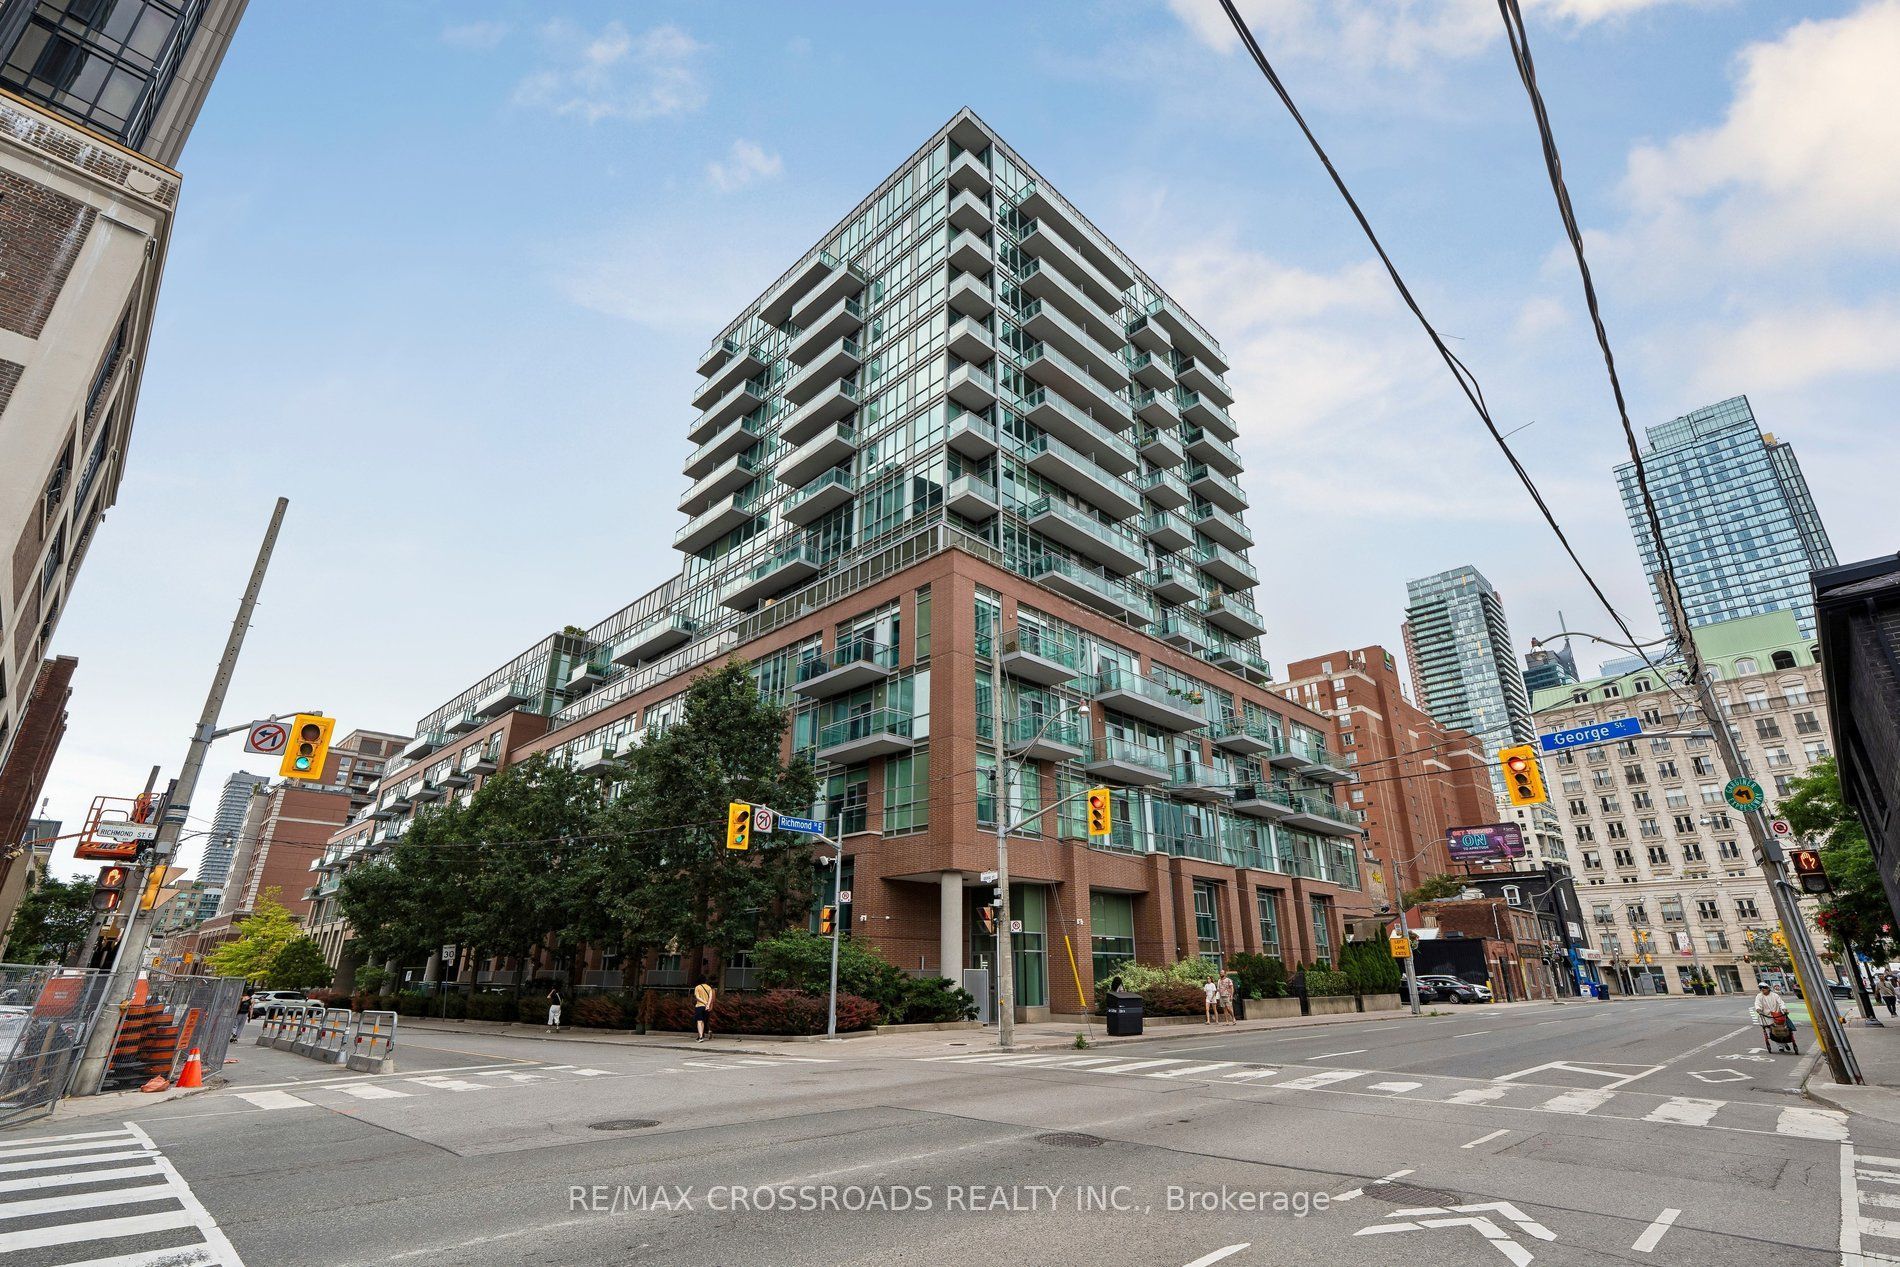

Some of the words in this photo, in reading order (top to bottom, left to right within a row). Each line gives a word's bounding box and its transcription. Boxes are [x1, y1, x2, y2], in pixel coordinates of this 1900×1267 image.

[1554, 727, 1609, 745] George
[781, 817, 812, 830] Richmond
[818, 823, 822, 831] E
[100, 829, 133, 837] RICHMOND
[1462, 834, 1487, 847] ON
[443, 950, 455, 959] 30
